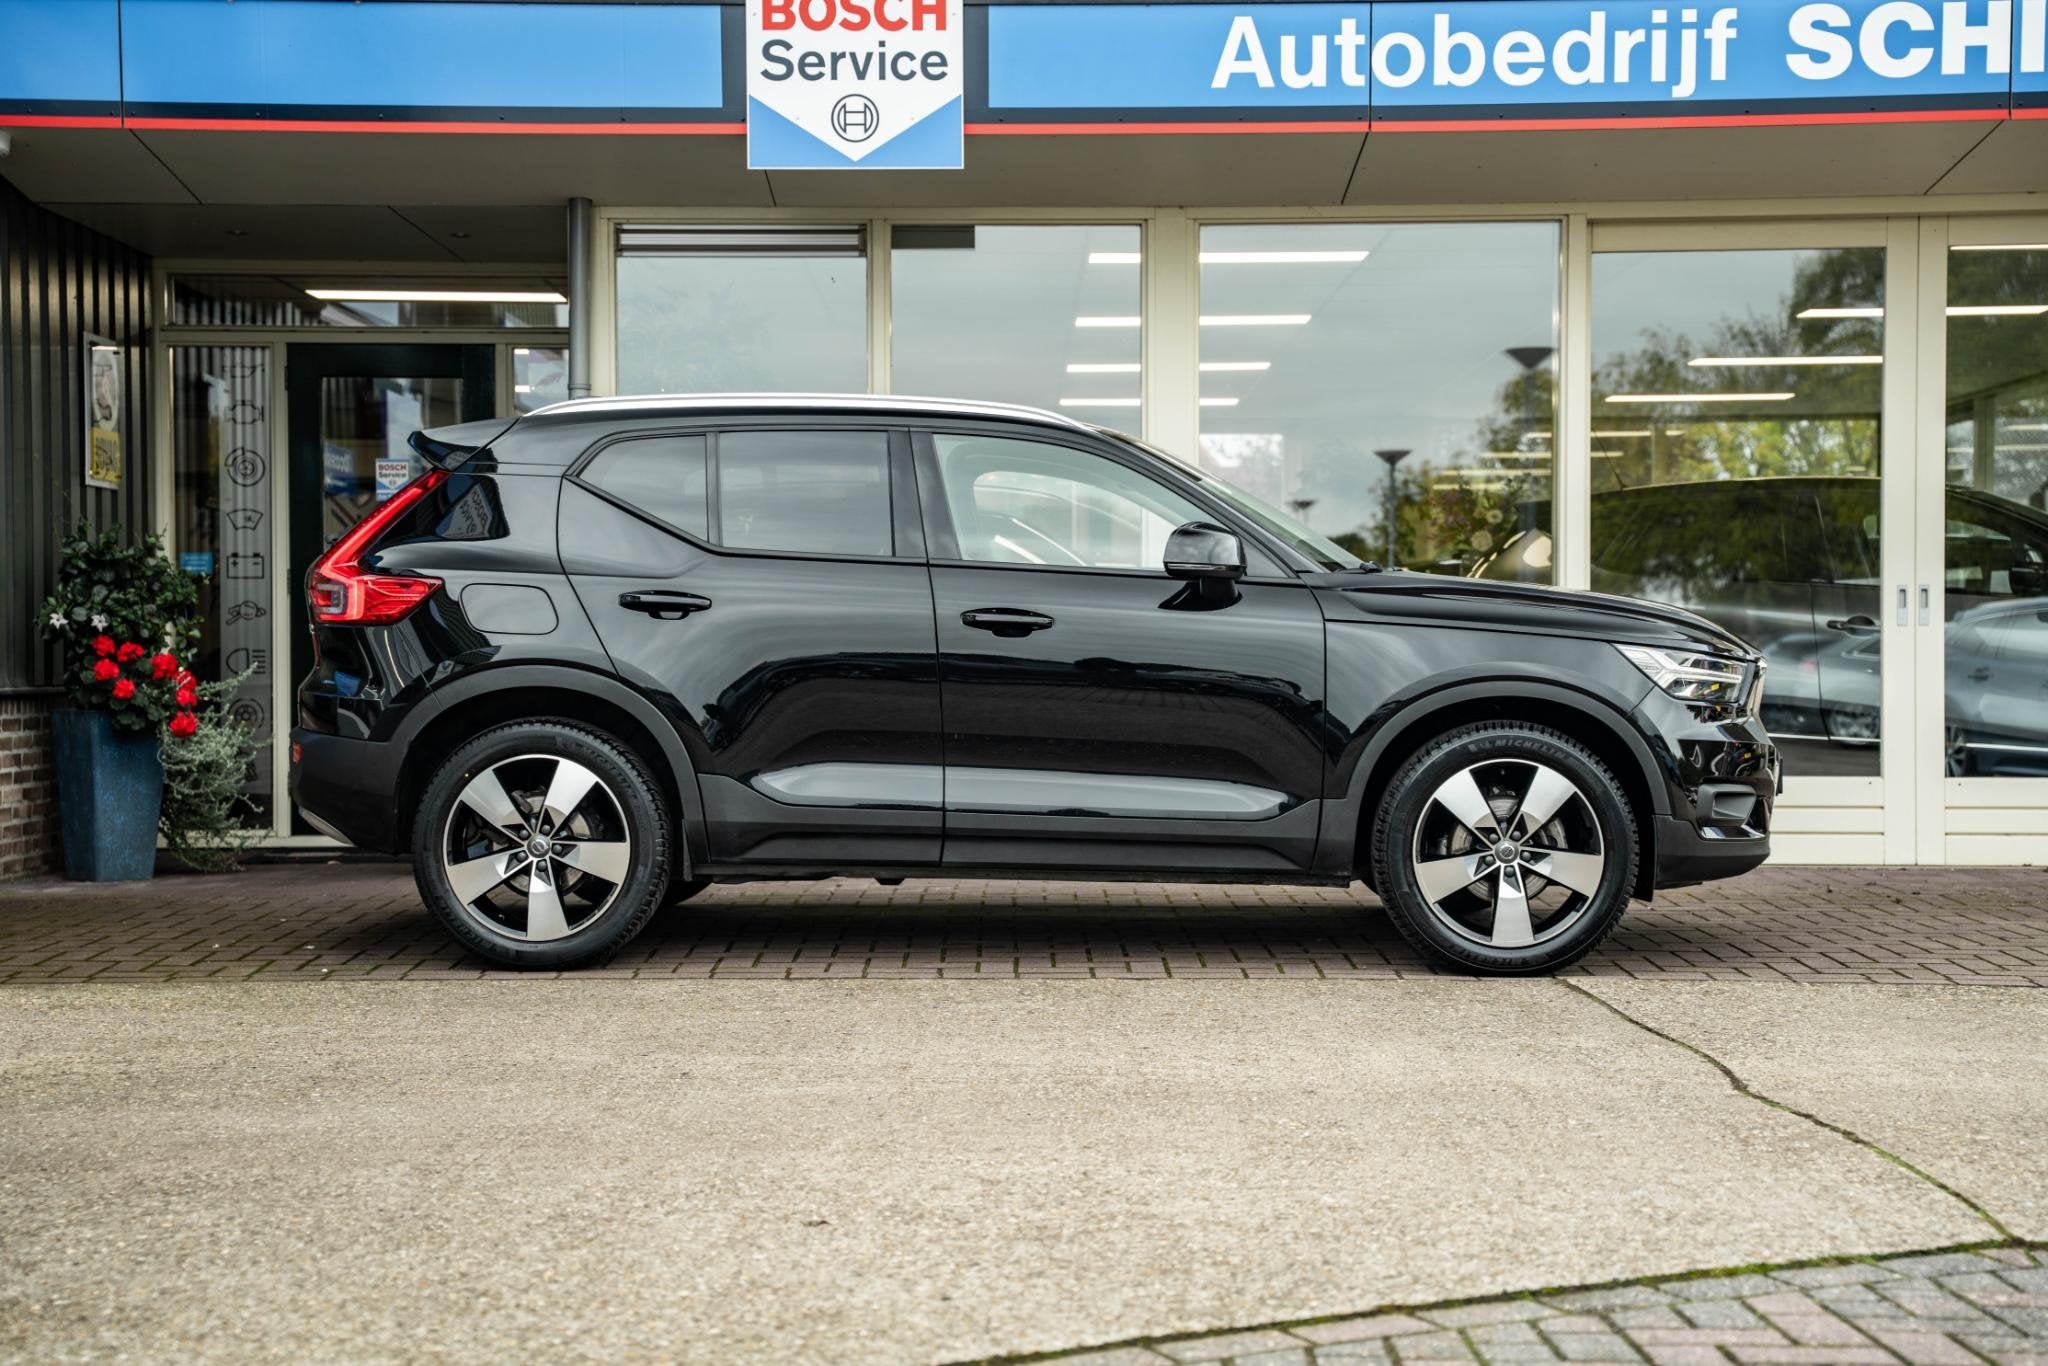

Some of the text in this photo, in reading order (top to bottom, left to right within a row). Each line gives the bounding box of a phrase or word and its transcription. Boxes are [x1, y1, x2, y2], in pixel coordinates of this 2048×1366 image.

[762, 0, 947, 31] BOSCH
[760, 39, 948, 81] Service
[1211, 9, 1737, 98] Autobedrijf
[378, 463, 407, 471] BOSCH
[1495, 739, 1567, 760] MICHELIN
